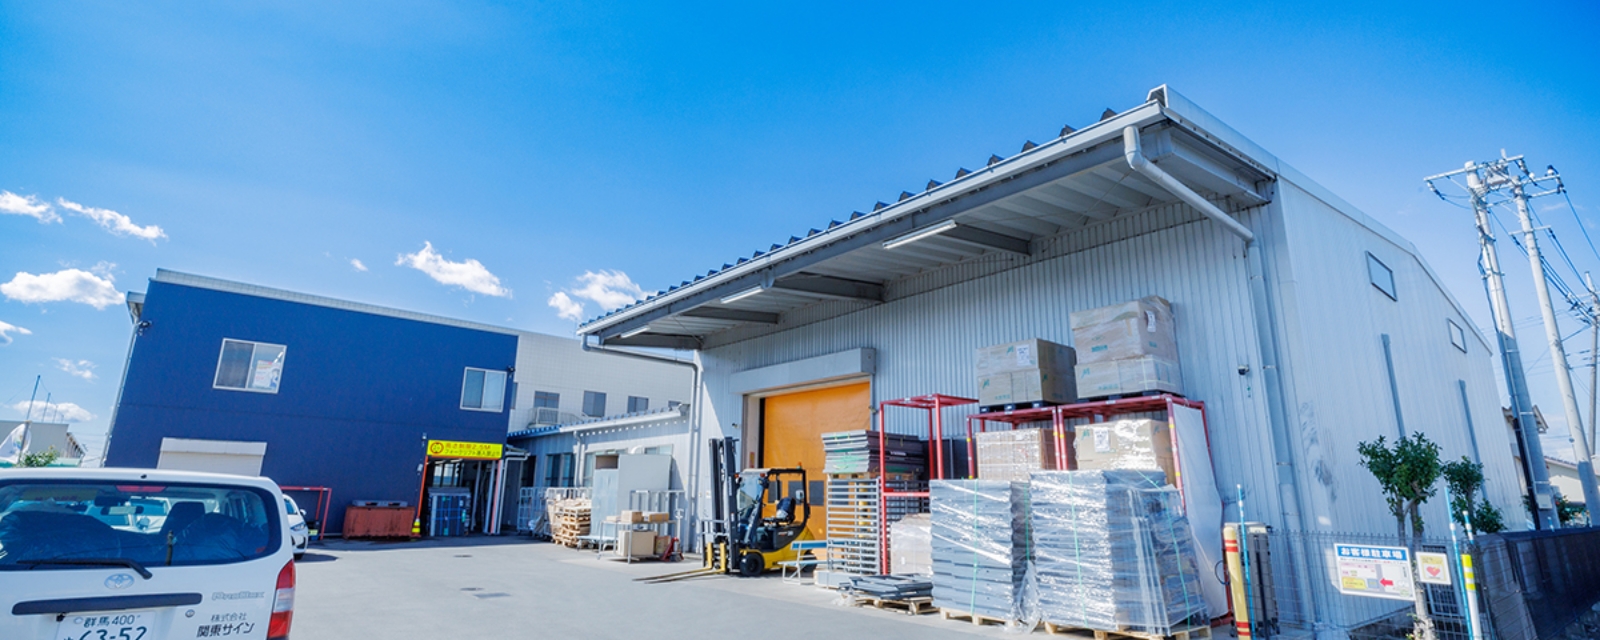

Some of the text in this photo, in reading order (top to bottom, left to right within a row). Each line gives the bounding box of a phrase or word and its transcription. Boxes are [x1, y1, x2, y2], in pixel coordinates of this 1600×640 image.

[1341, 547, 1403, 560] お客様駐車場
[83, 614, 135, 628] 群馬 400
[211, 612, 247, 622] 株式会社
[197, 622, 255, 637] 関東サイン
